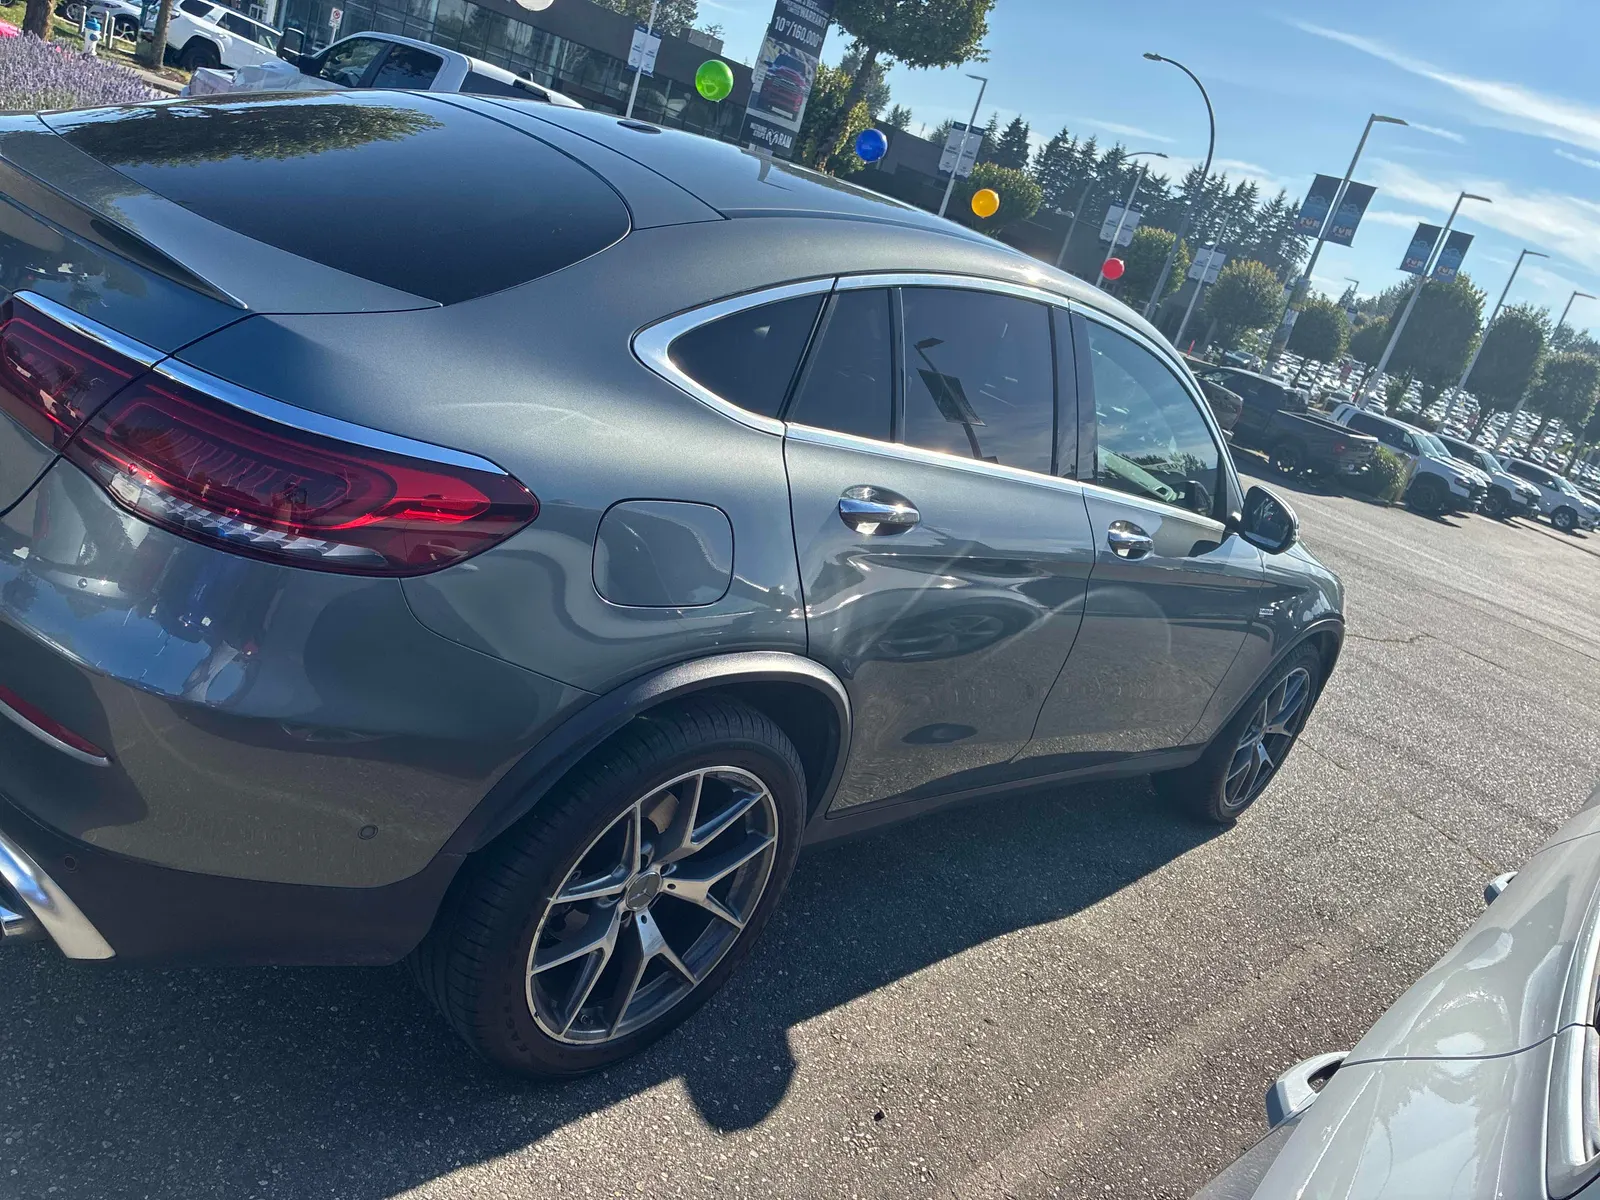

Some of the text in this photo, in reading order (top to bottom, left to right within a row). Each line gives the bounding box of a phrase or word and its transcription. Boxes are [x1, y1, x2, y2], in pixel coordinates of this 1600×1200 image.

[777, 133, 792, 149] RAM
[1300, 216, 1320, 228] FUN
[1333, 225, 1352, 236] FUN
